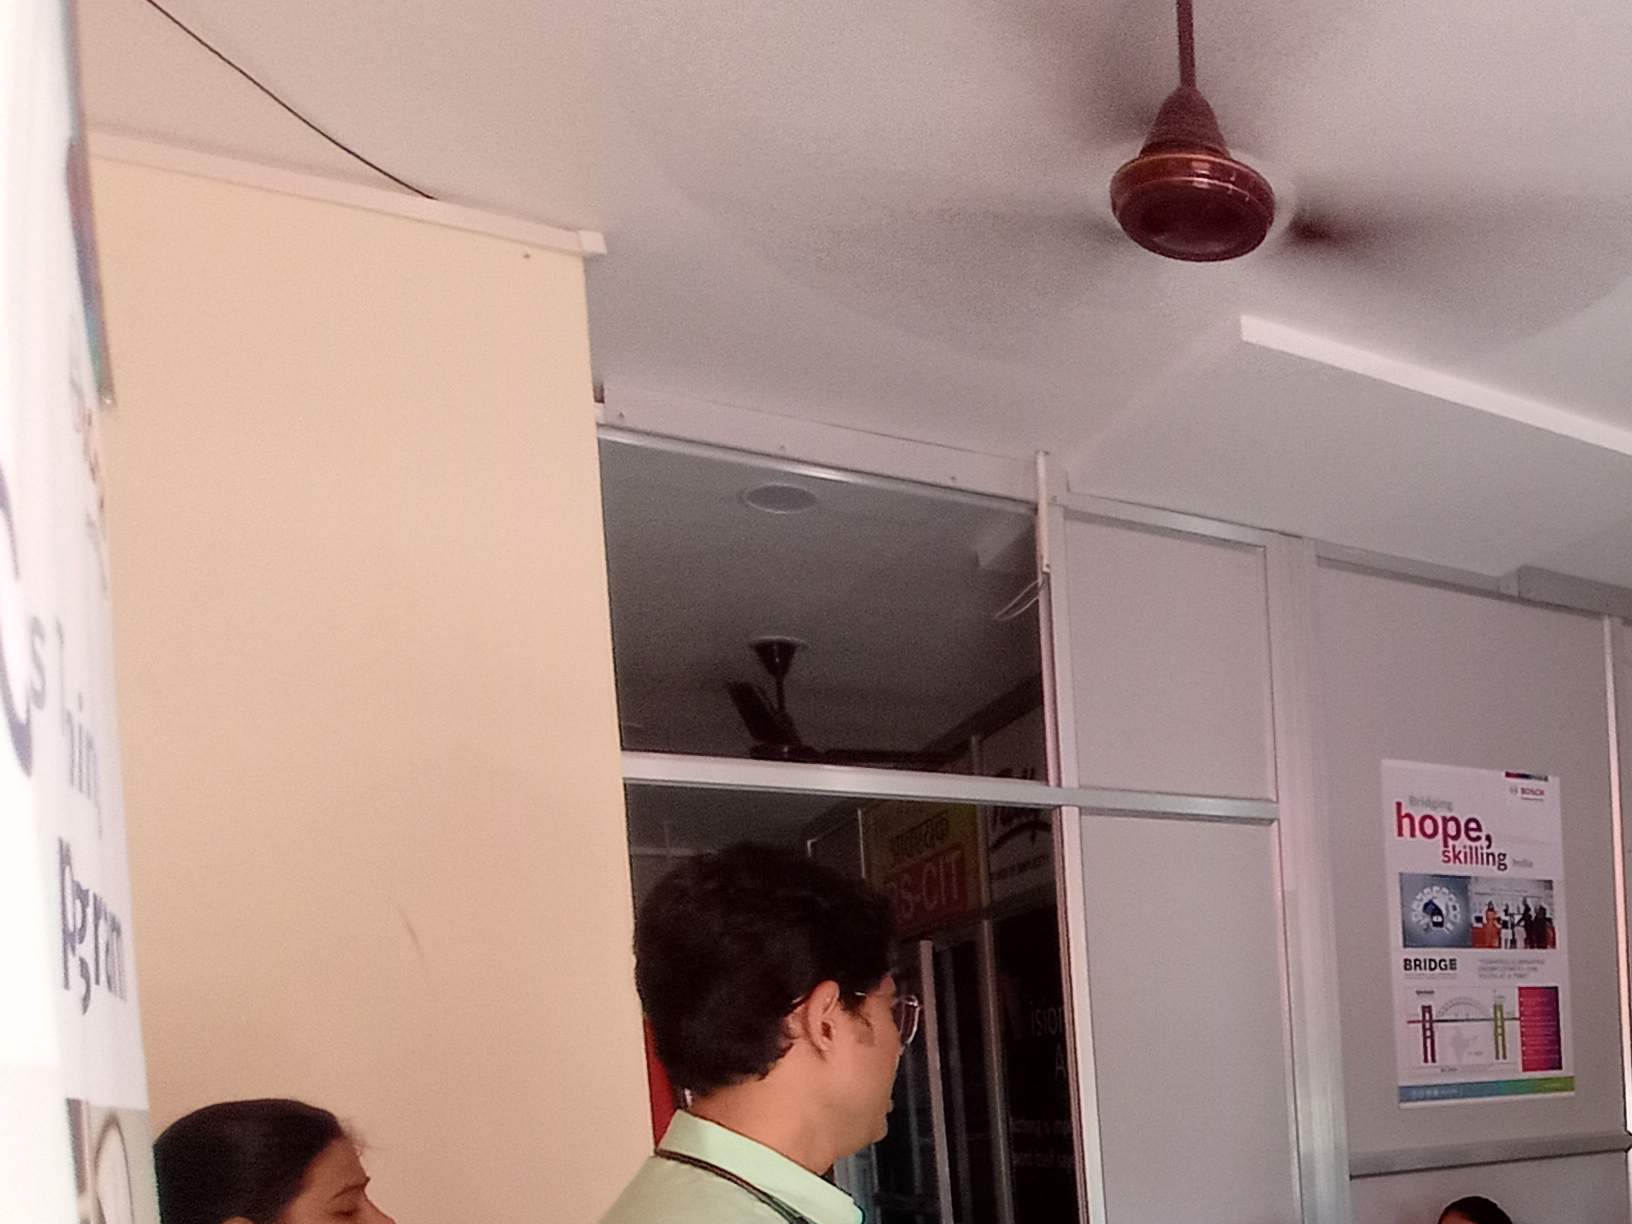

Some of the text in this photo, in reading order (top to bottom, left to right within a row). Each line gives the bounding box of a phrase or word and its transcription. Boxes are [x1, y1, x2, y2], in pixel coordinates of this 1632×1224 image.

[1520, 787, 1545, 797] BOSCH
[1396, 801, 1492, 849] hope,
[1442, 844, 1508, 872] skilling
[1403, 958, 1458, 972] BRIDGE
